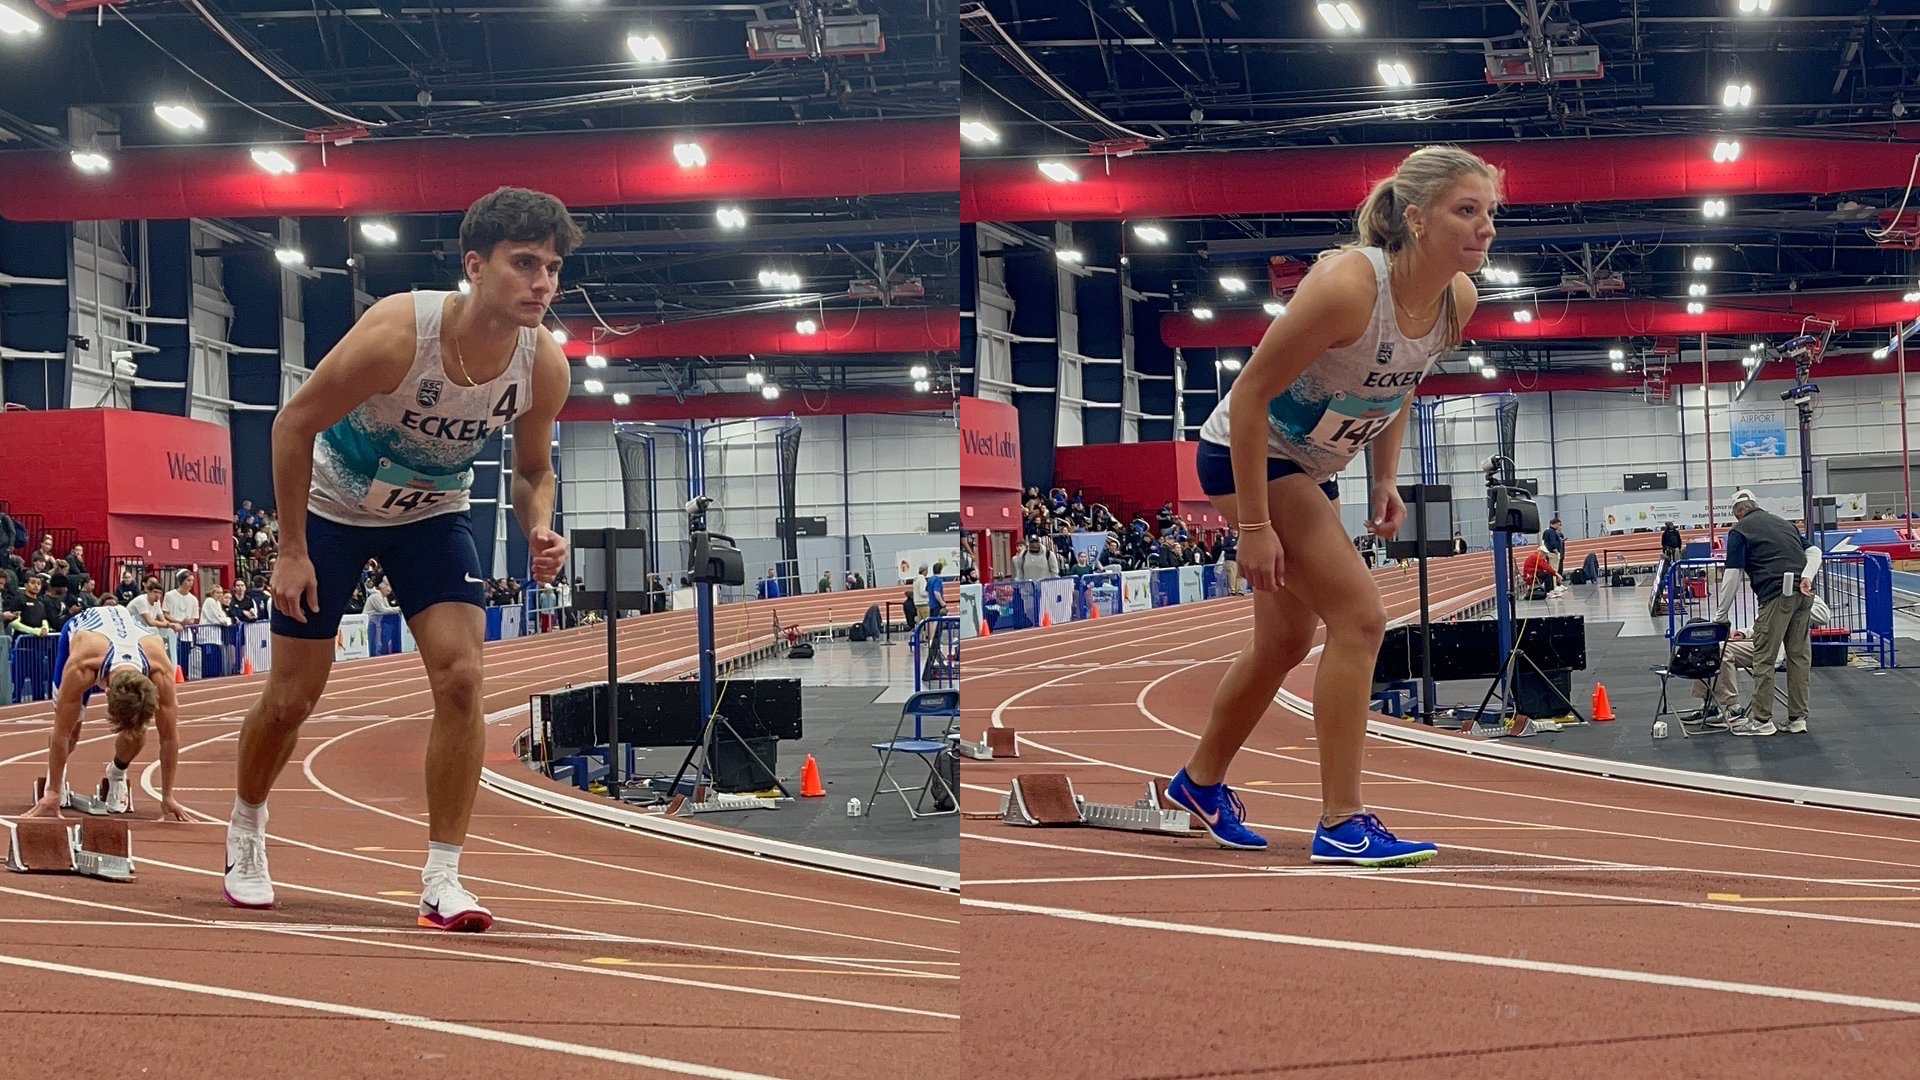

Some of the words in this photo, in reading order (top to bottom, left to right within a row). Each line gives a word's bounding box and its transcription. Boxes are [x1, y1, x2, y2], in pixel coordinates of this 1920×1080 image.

[421, 381, 441, 390] SSC
[492, 383, 518, 424] 4
[1740, 414, 1775, 423] AIRPORT
[1330, 416, 1390, 446] 142
[961, 428, 994, 457] West
[994, 431, 1016, 467] Lobby
[166, 451, 202, 482] West
[203, 454, 226, 495] Lobby
[381, 488, 447, 512] 145
